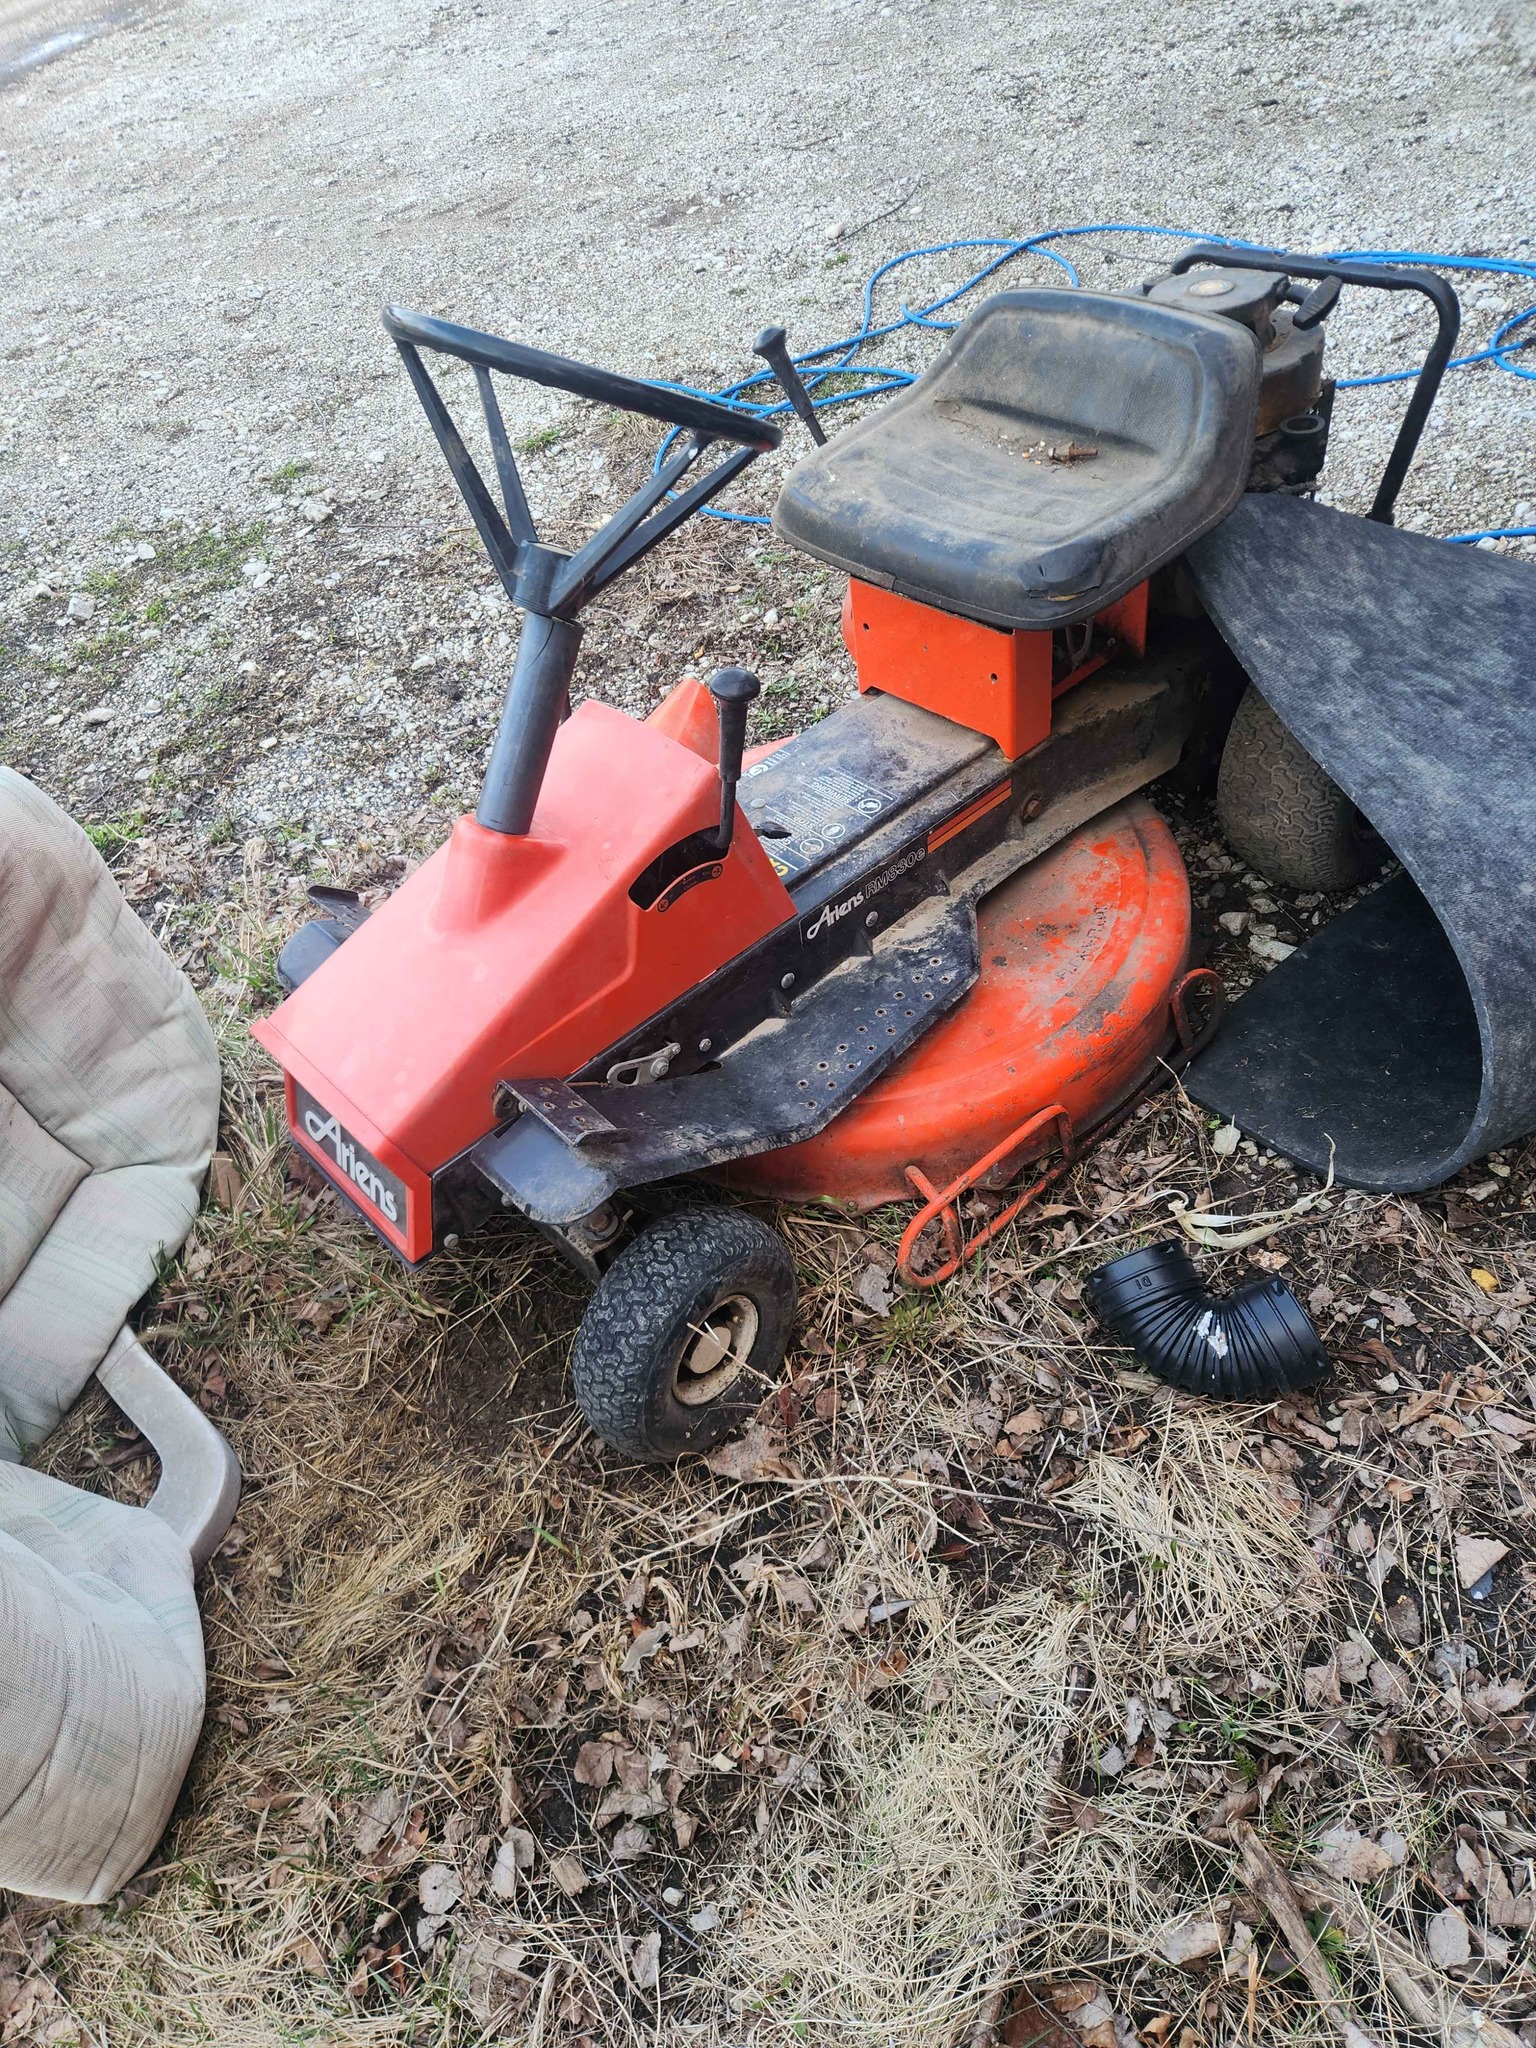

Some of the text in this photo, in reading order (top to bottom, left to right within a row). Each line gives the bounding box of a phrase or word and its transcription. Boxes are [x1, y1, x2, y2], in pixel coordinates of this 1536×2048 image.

[811, 781, 852, 804] SERVICING
[806, 847, 926, 940] Ariens RM830e
[305, 1110, 397, 1222] Ariens
